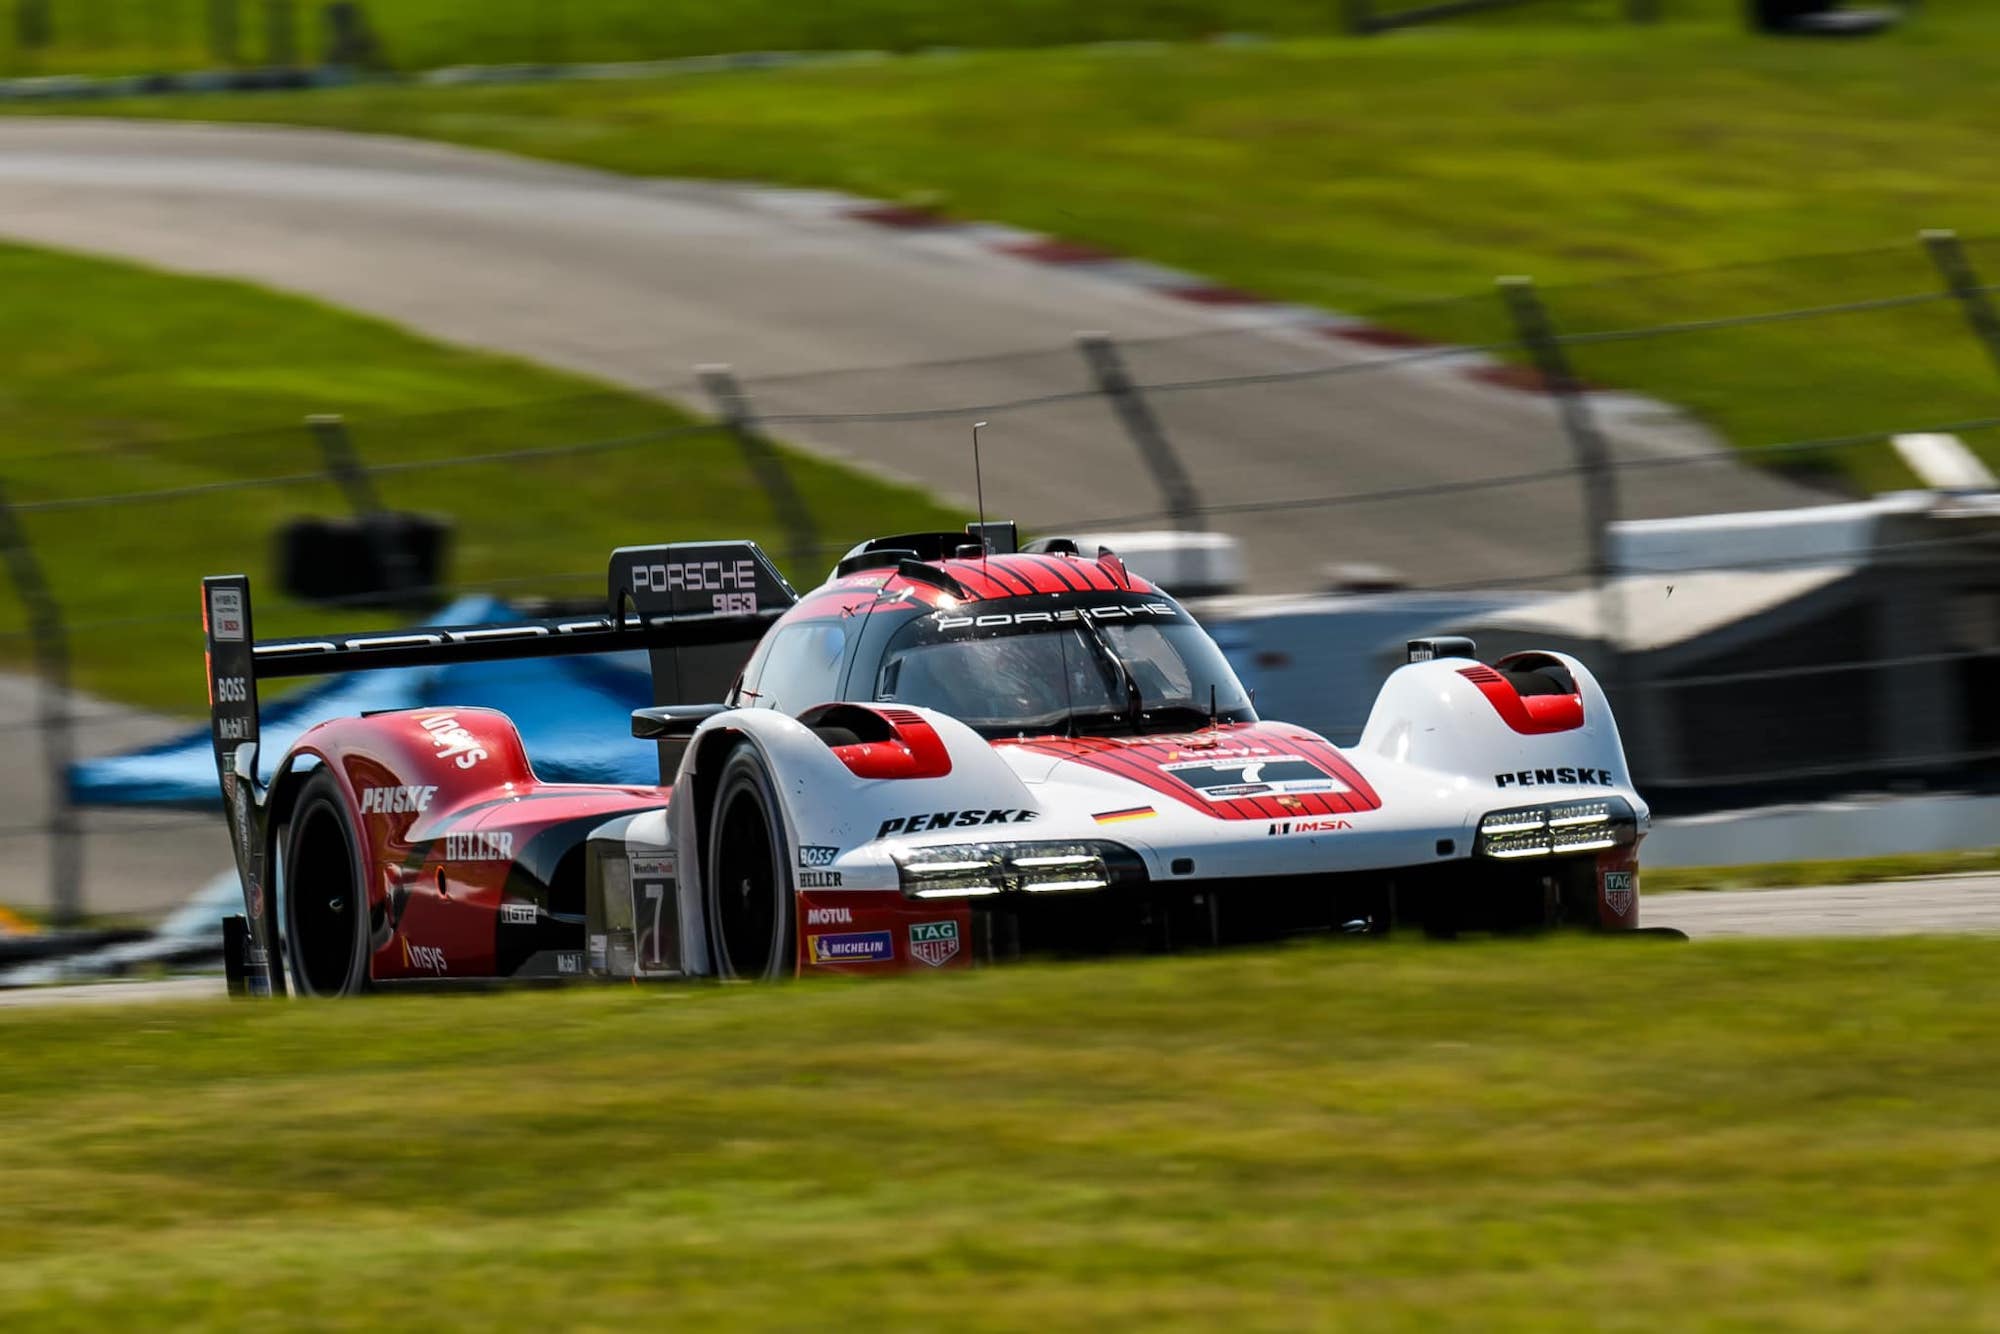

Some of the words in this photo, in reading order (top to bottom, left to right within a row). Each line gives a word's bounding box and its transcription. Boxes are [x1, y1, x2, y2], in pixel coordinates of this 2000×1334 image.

[632, 560, 755, 593] PORSCHE
[713, 593, 757, 614] 963
[937, 603, 1176, 631] PORSCHE
[218, 678, 246, 702] BOSS
[220, 718, 241, 739] Mobil
[410, 712, 488, 769] Ansys
[1212, 763, 1265, 783] 7
[1495, 767, 1613, 788] PENSKE
[361, 785, 438, 814] PENSKE
[876, 809, 1040, 838] PENSKE
[1295, 820, 1352, 832] IMSA
[446, 832, 513, 860] HELLER
[800, 847, 834, 866] BOSS
[800, 872, 842, 887] HELLER
[1608, 875, 1631, 889] TAG
[645, 884, 663, 963] 7
[808, 908, 852, 924] MOTUL
[913, 923, 953, 940] TAG
[401, 936, 447, 975] Ansys
[831, 941, 883, 954] MICHELIN
[913, 940, 956, 961] HEUER
